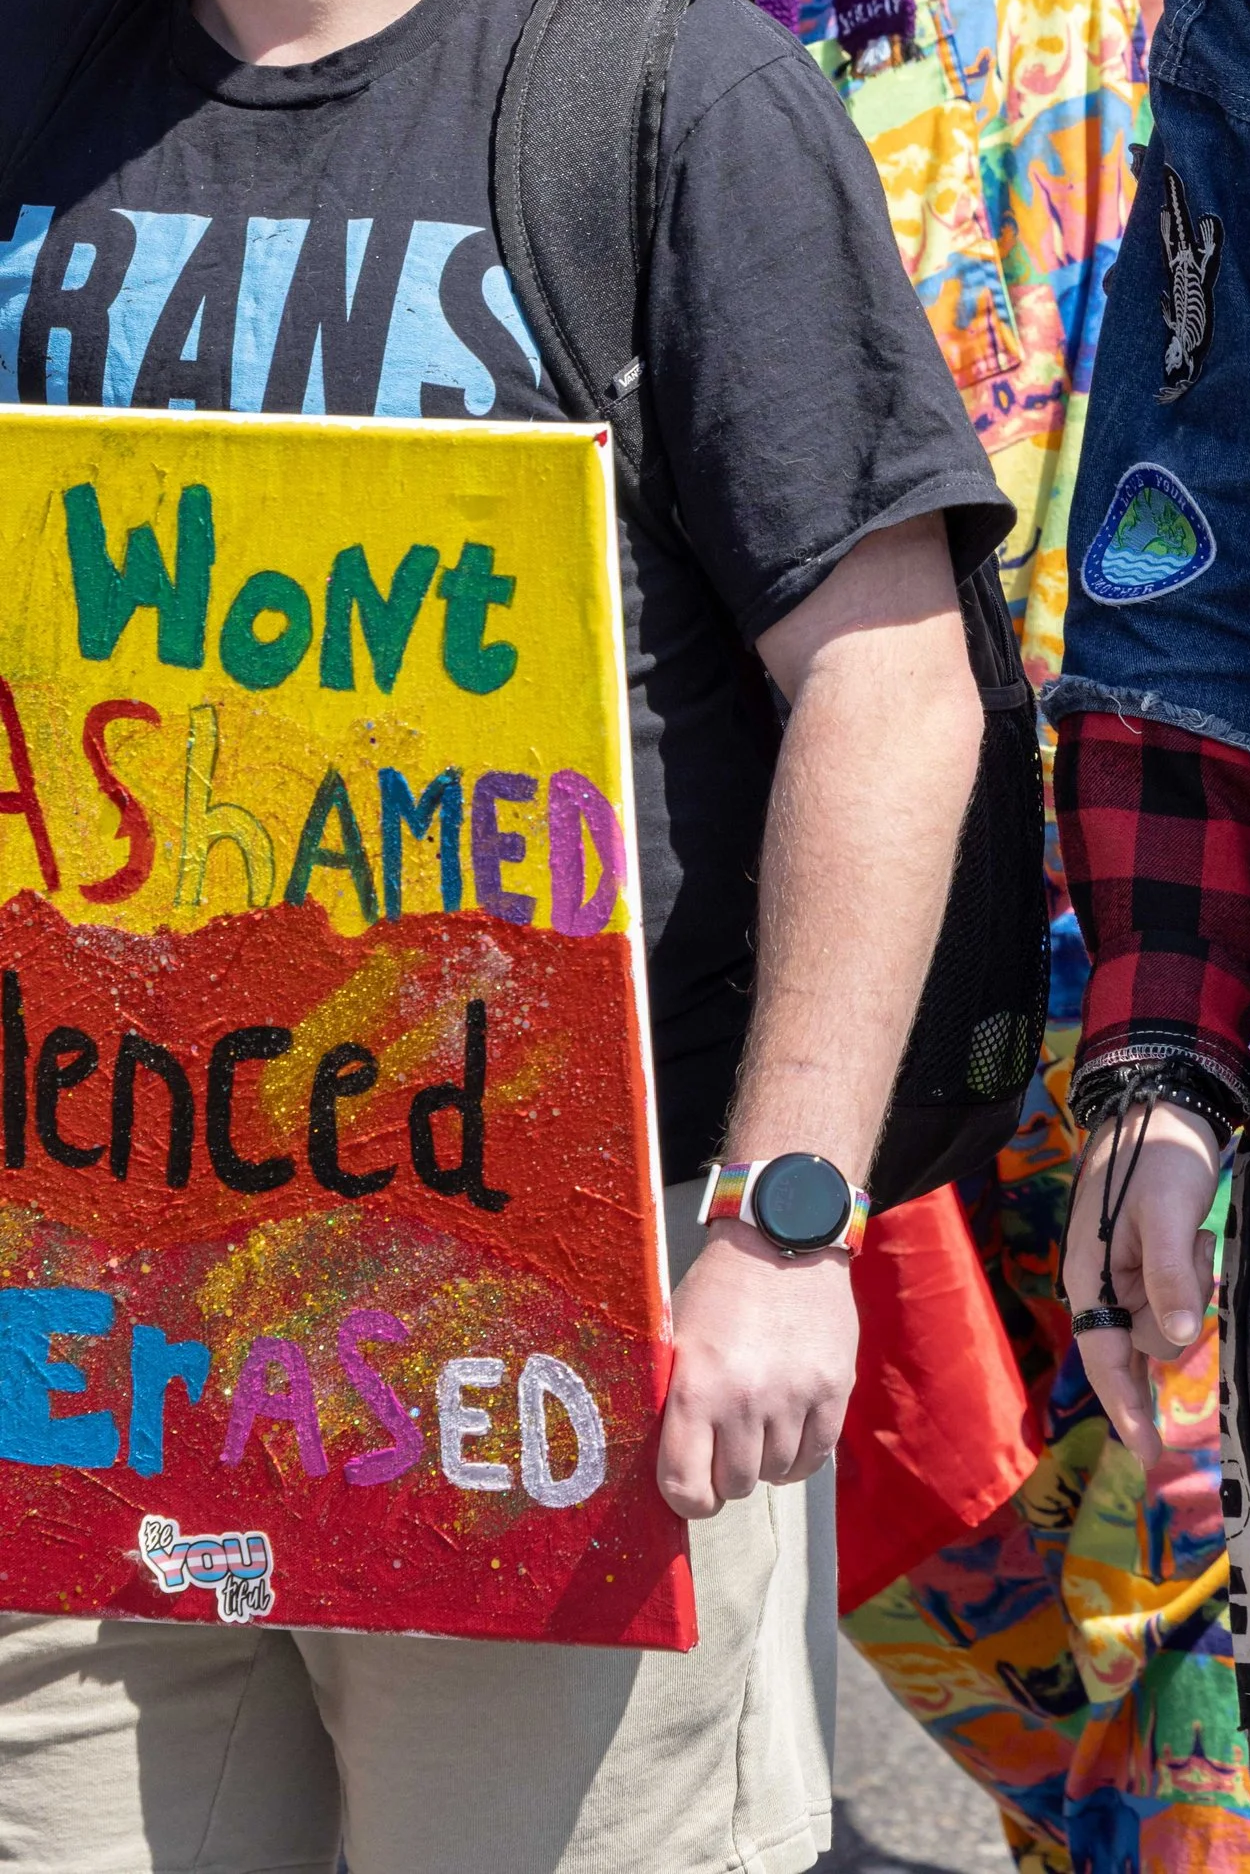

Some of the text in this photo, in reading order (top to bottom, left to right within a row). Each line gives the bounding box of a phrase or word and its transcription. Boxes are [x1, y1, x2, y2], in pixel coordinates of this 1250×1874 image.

[1155, 474, 1188, 511] YOUR
[1091, 578, 1155, 599] MOTHER
[145, 1521, 173, 1552] Be
[147, 1536, 268, 1588] YOU
[222, 1573, 271, 1618] tiful
